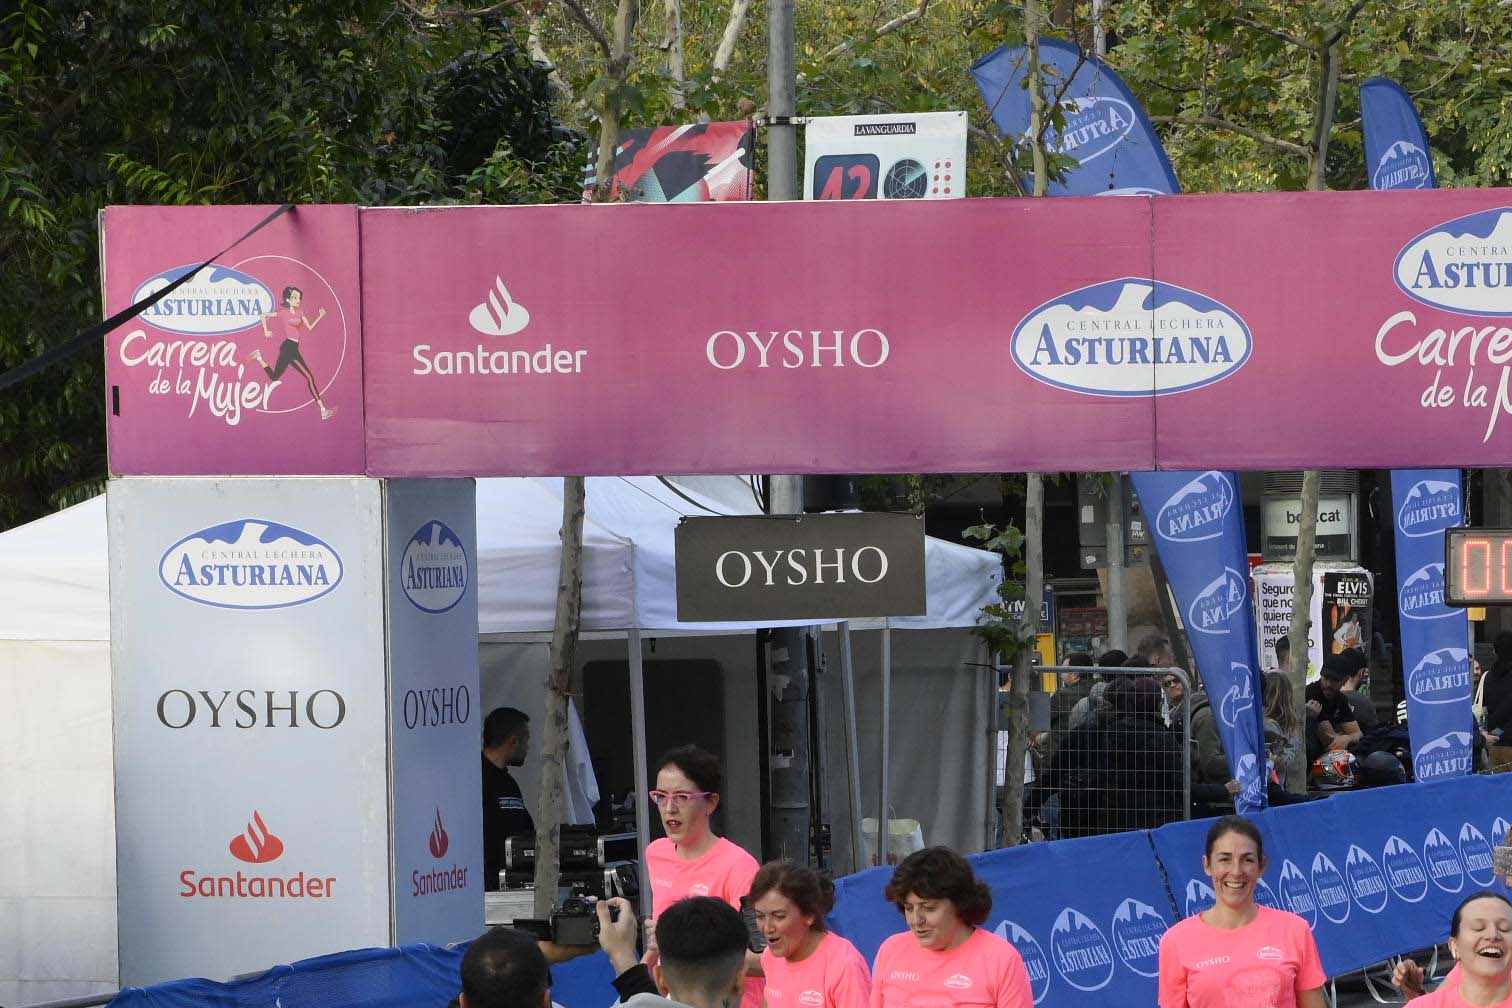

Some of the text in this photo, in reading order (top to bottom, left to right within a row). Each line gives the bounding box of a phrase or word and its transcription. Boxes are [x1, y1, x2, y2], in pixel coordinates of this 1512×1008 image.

[866, 124, 914, 134] VANGUARDIA
[172, 288, 208, 296] ENTRAL
[1066, 320, 1144, 332] CENTRAL
[119, 329, 238, 367] Carrera
[413, 343, 588, 376] Santander
[706, 328, 890, 369] OYSHO
[1029, 323, 1234, 367] ASTURIANA
[149, 364, 282, 426] de la Mujer
[1421, 370, 1455, 408] de
[1464, 369, 1488, 408] la
[173, 553, 330, 587] ASTURIANA
[201, 550, 324, 559] CENTRAL LECHERA
[715, 546, 889, 588] OYSHO
[406, 558, 464, 590] ASTURIANA
[1337, 581, 1368, 594] ELVIS
[1262, 599, 1279, 608] que
[156, 689, 346, 729] OYSHO
[404, 684, 471, 730] OYSHO
[180, 869, 337, 898] Santander
[413, 866, 468, 896] Santander
[1057, 942, 1112, 974] ASTURIANA
